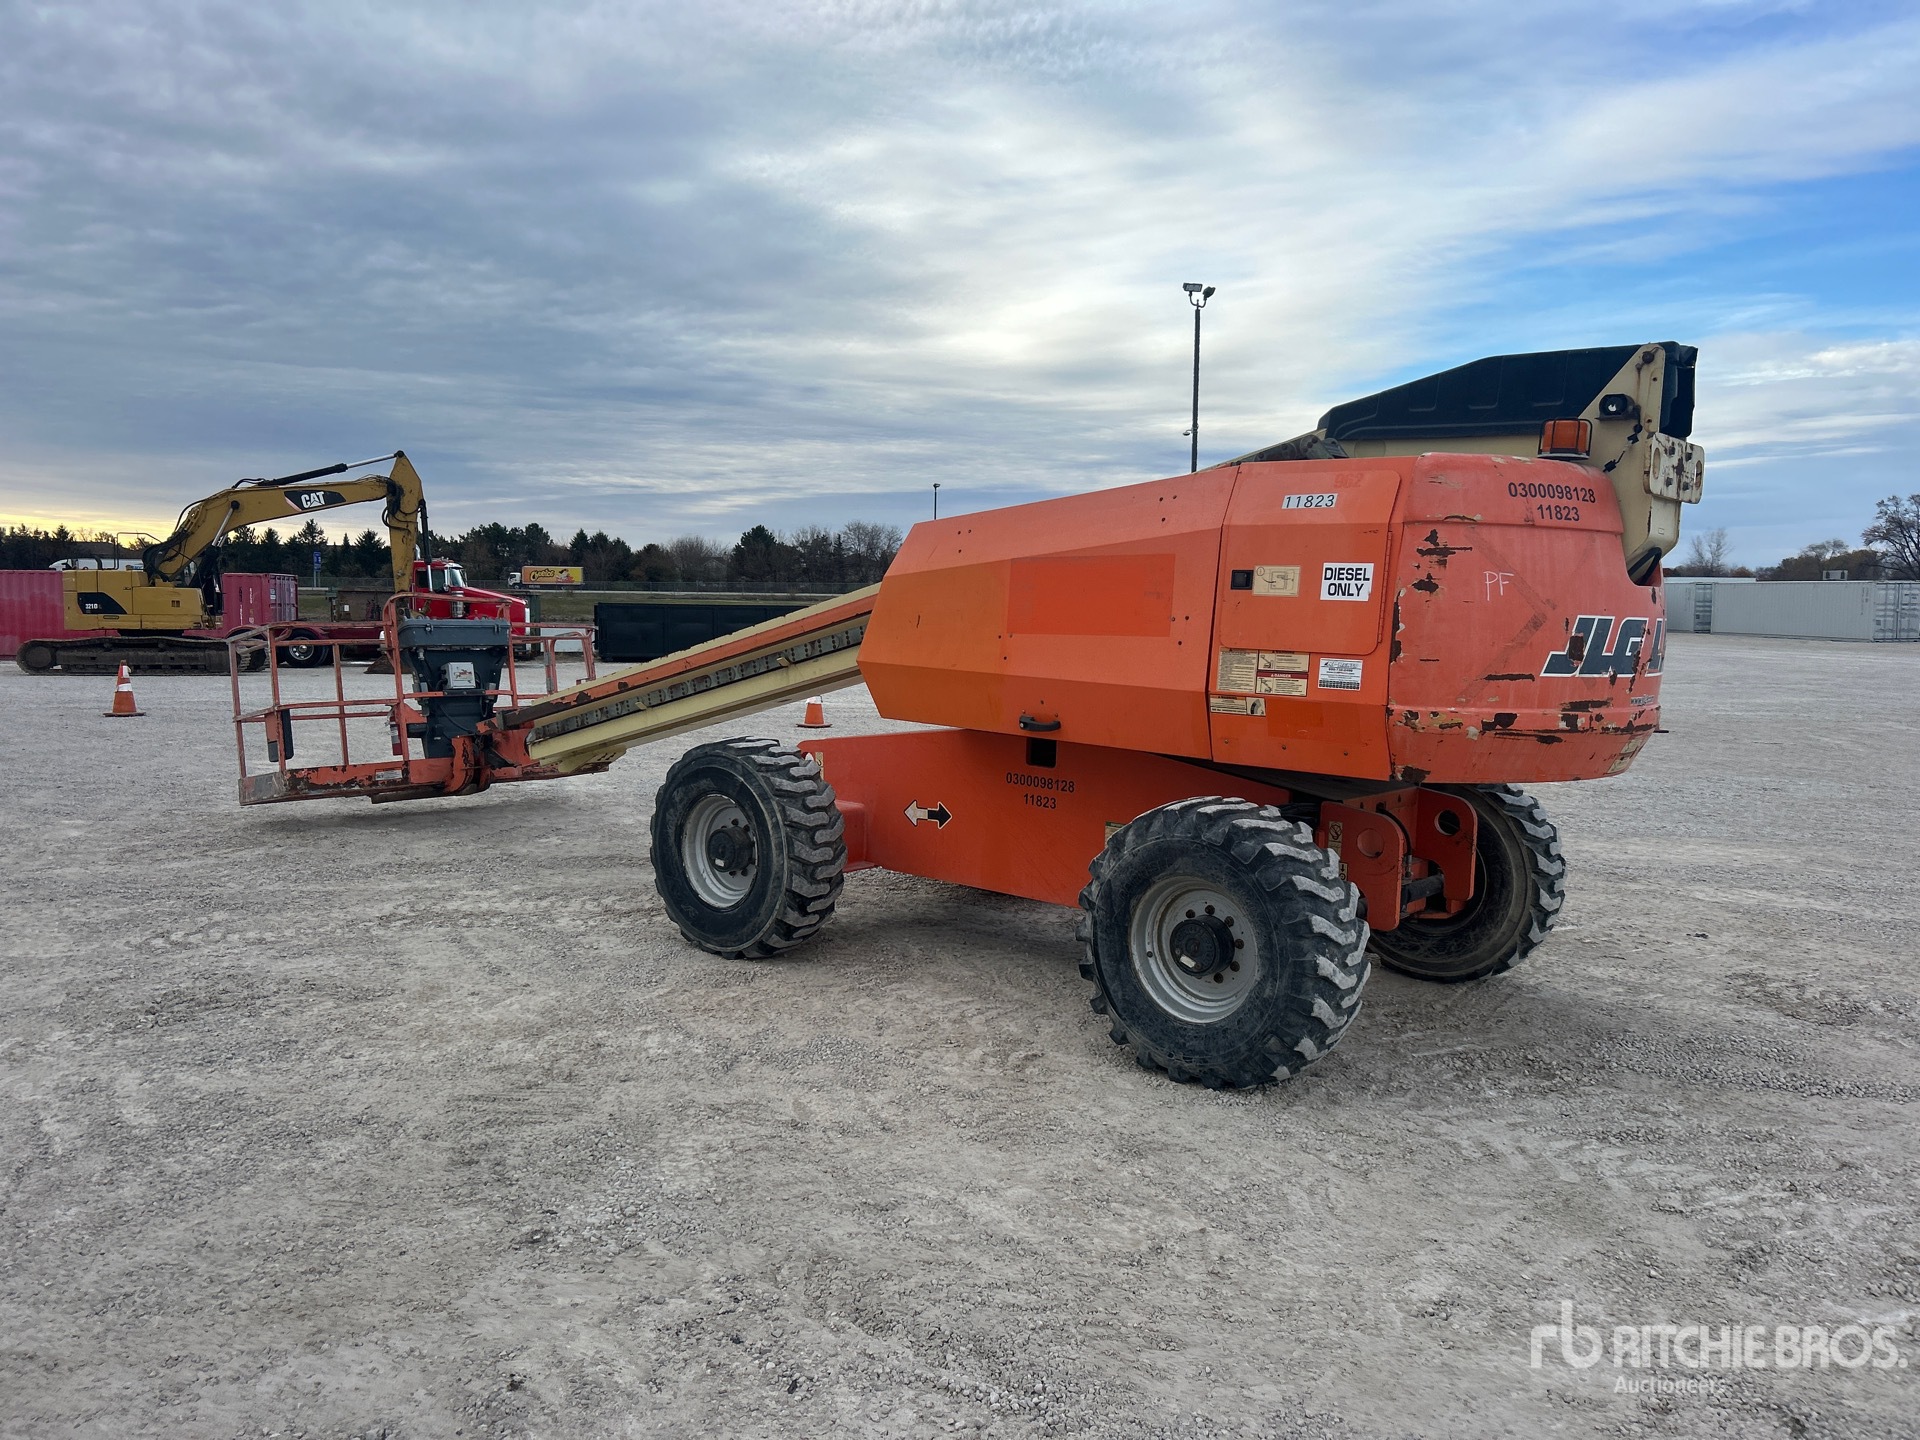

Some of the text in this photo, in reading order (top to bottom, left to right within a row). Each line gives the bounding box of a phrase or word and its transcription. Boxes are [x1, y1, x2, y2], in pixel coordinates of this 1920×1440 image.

[301, 491, 325, 509] CAT
[1286, 494, 1335, 508] 11823
[1508, 482, 1596, 503] 0300098128
[1537, 504, 1580, 521] 11823
[1323, 567, 1371, 581] DIESEL
[1327, 583, 1364, 597] ONLY
[1483, 571, 1514, 601] PF
[1540, 615, 1650, 678] JLG
[1005, 772, 1075, 793] 0300098128
[1023, 793, 1057, 809] 11823
